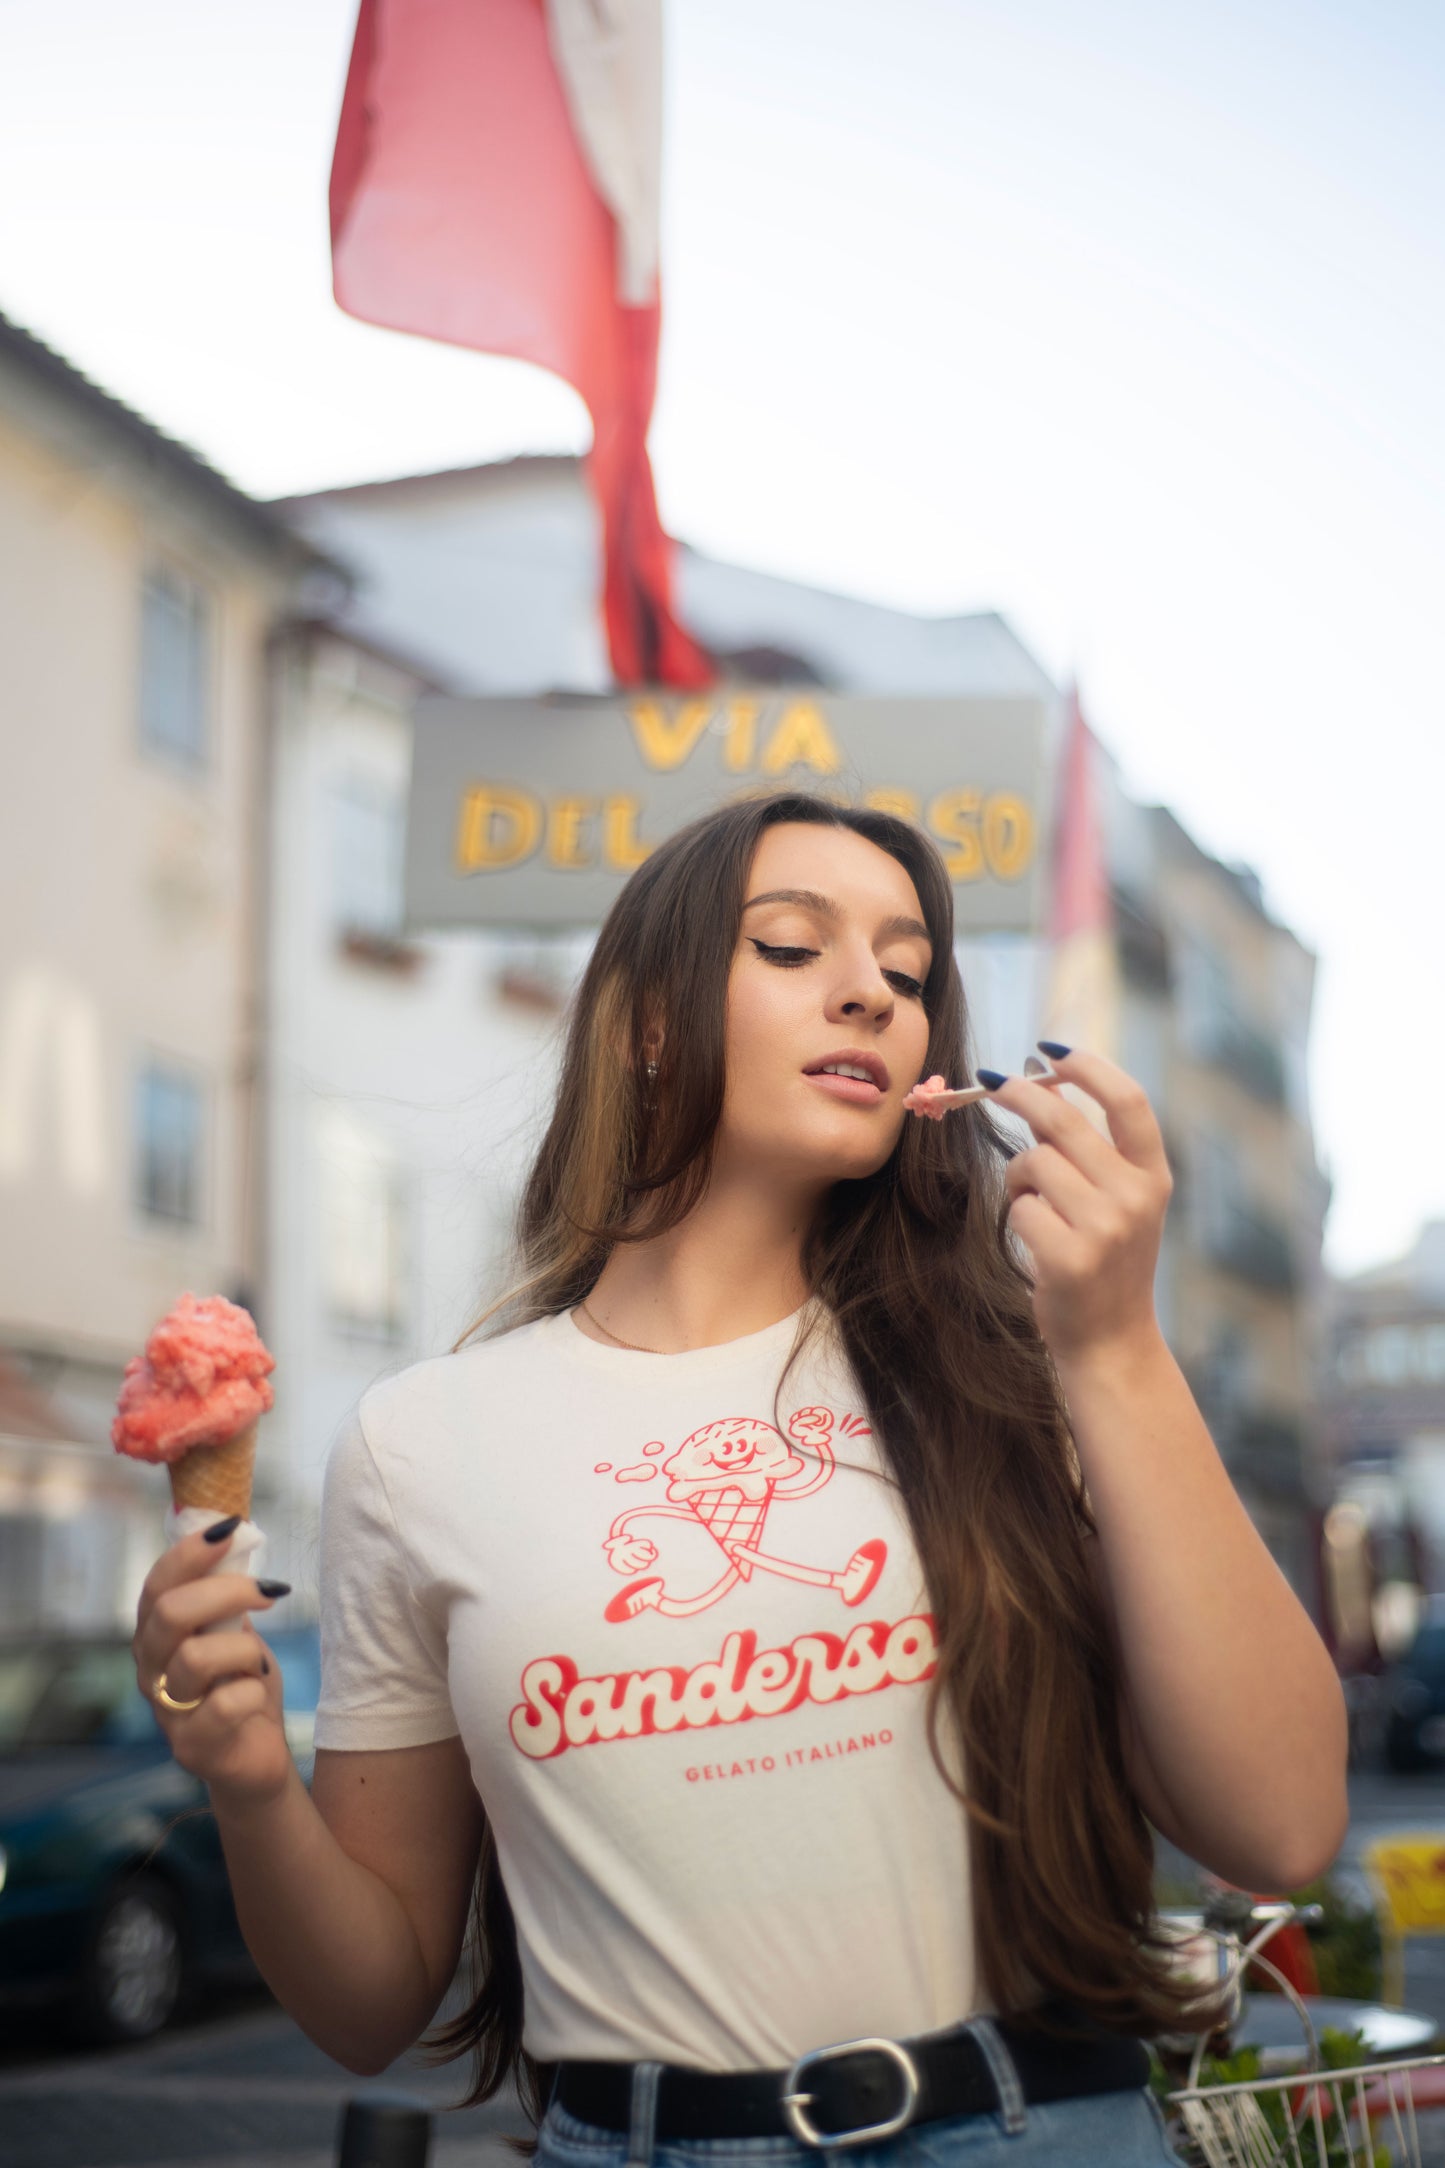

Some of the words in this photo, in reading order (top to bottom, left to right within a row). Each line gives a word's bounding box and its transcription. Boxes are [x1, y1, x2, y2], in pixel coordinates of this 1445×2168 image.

[630, 697, 840, 775] VIA
[456, 784, 655, 874] DEL
[508, 1612, 939, 1761] Sanderso
[685, 1756, 776, 1783] GELATO
[785, 1728, 895, 1768] ITALIANO
